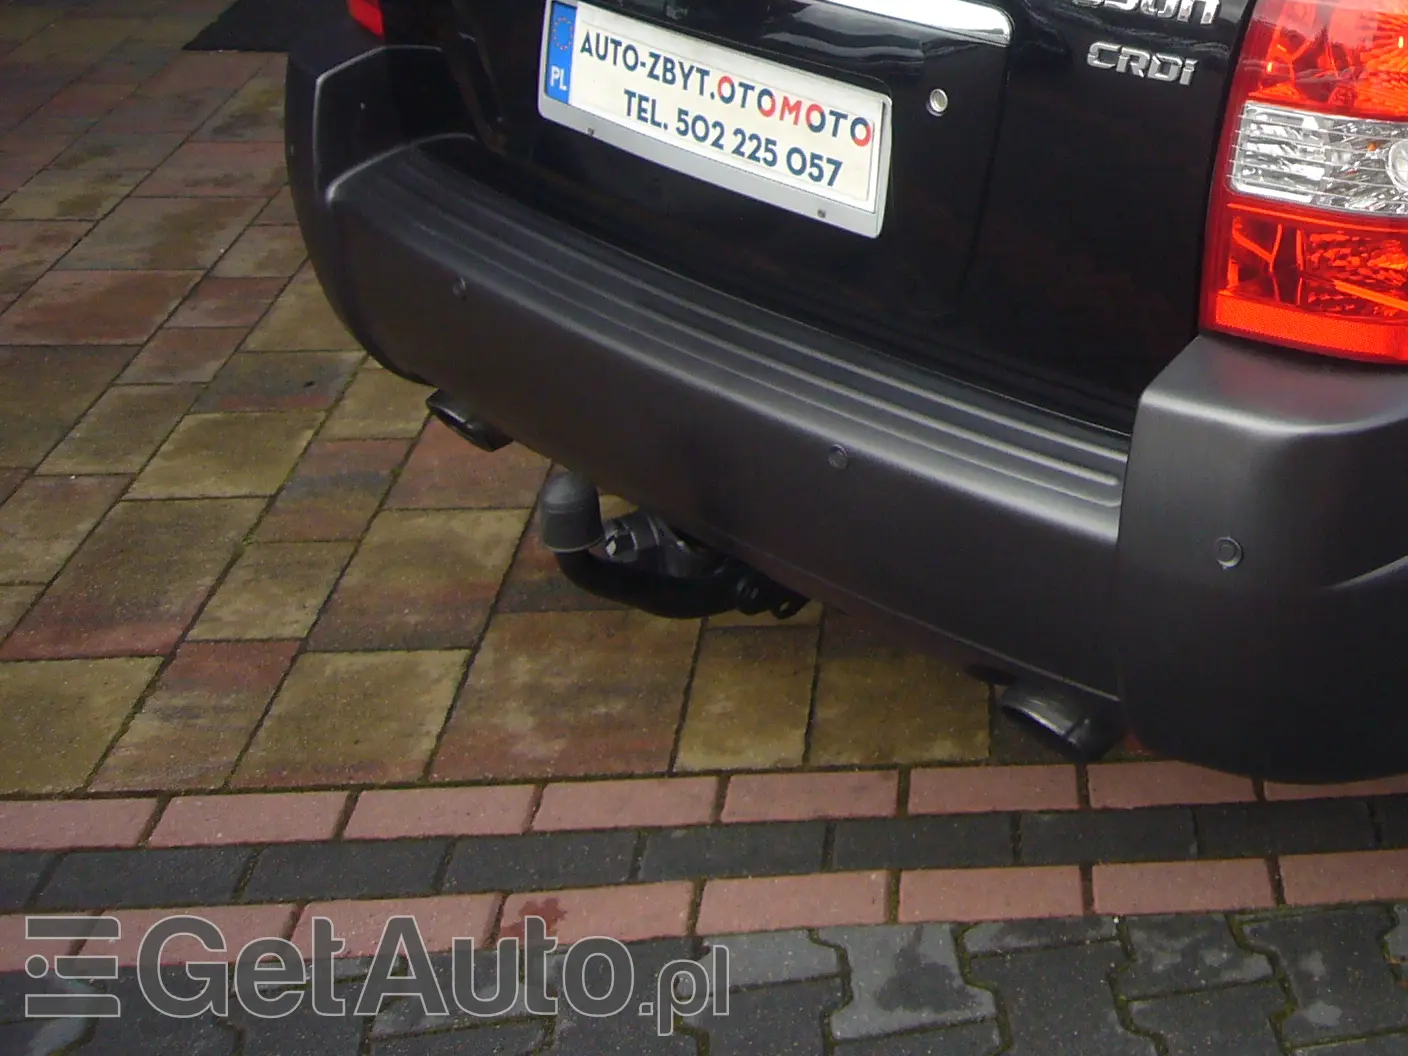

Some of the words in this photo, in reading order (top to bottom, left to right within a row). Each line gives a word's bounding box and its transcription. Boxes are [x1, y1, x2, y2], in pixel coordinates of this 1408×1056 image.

[549, 66, 568, 92] PL
[1087, 41, 1200, 86] CRDi
[624, 88, 669, 131] TEL.
[676, 108, 725, 150] 502
[731, 127, 778, 168] 225
[786, 146, 843, 187] 057
